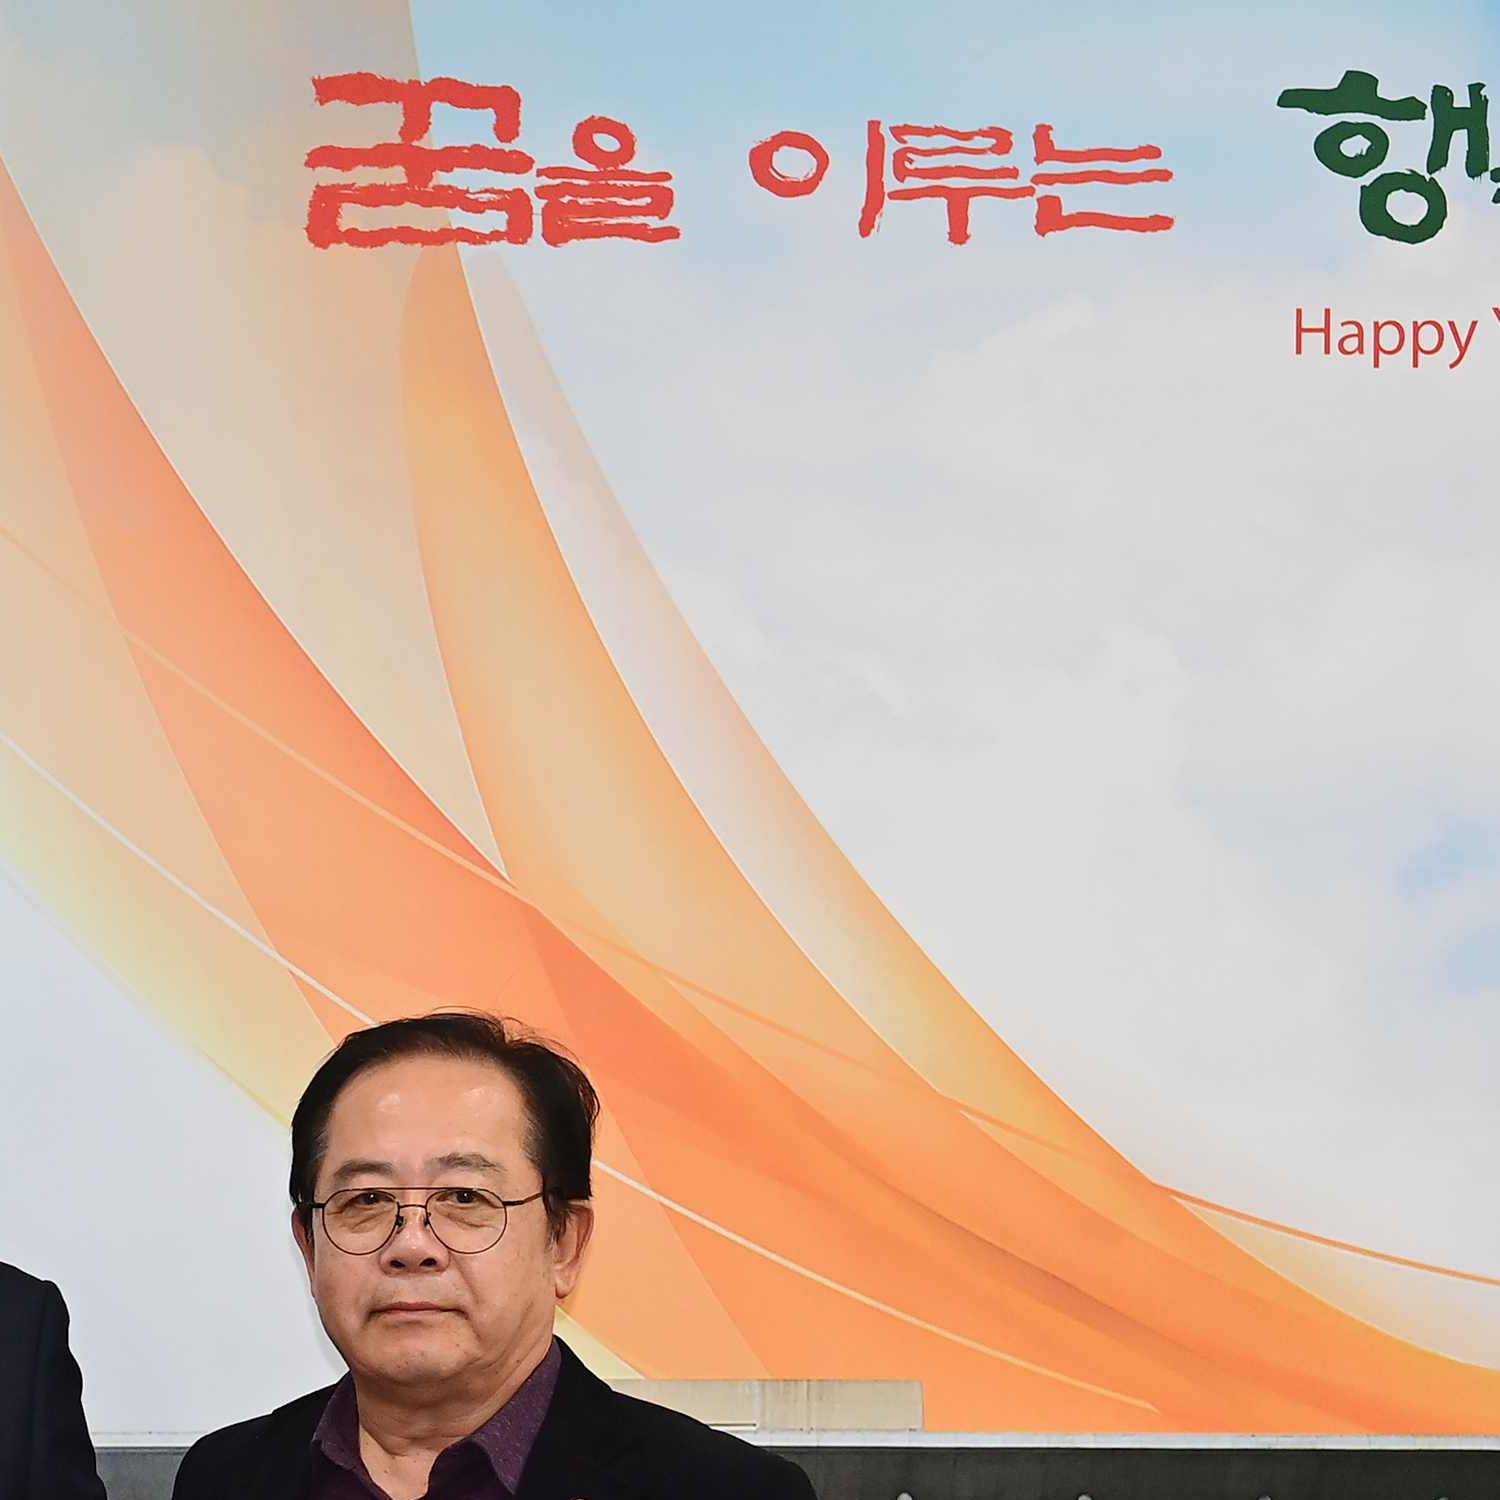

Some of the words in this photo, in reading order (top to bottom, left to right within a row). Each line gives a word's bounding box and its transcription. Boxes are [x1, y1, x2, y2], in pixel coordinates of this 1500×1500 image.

[303, 70, 681, 249] 꿈을
[748, 118, 1174, 246] 이루는
[1276, 69, 1500, 244] 행
[1294, 307, 1479, 369] Happy
